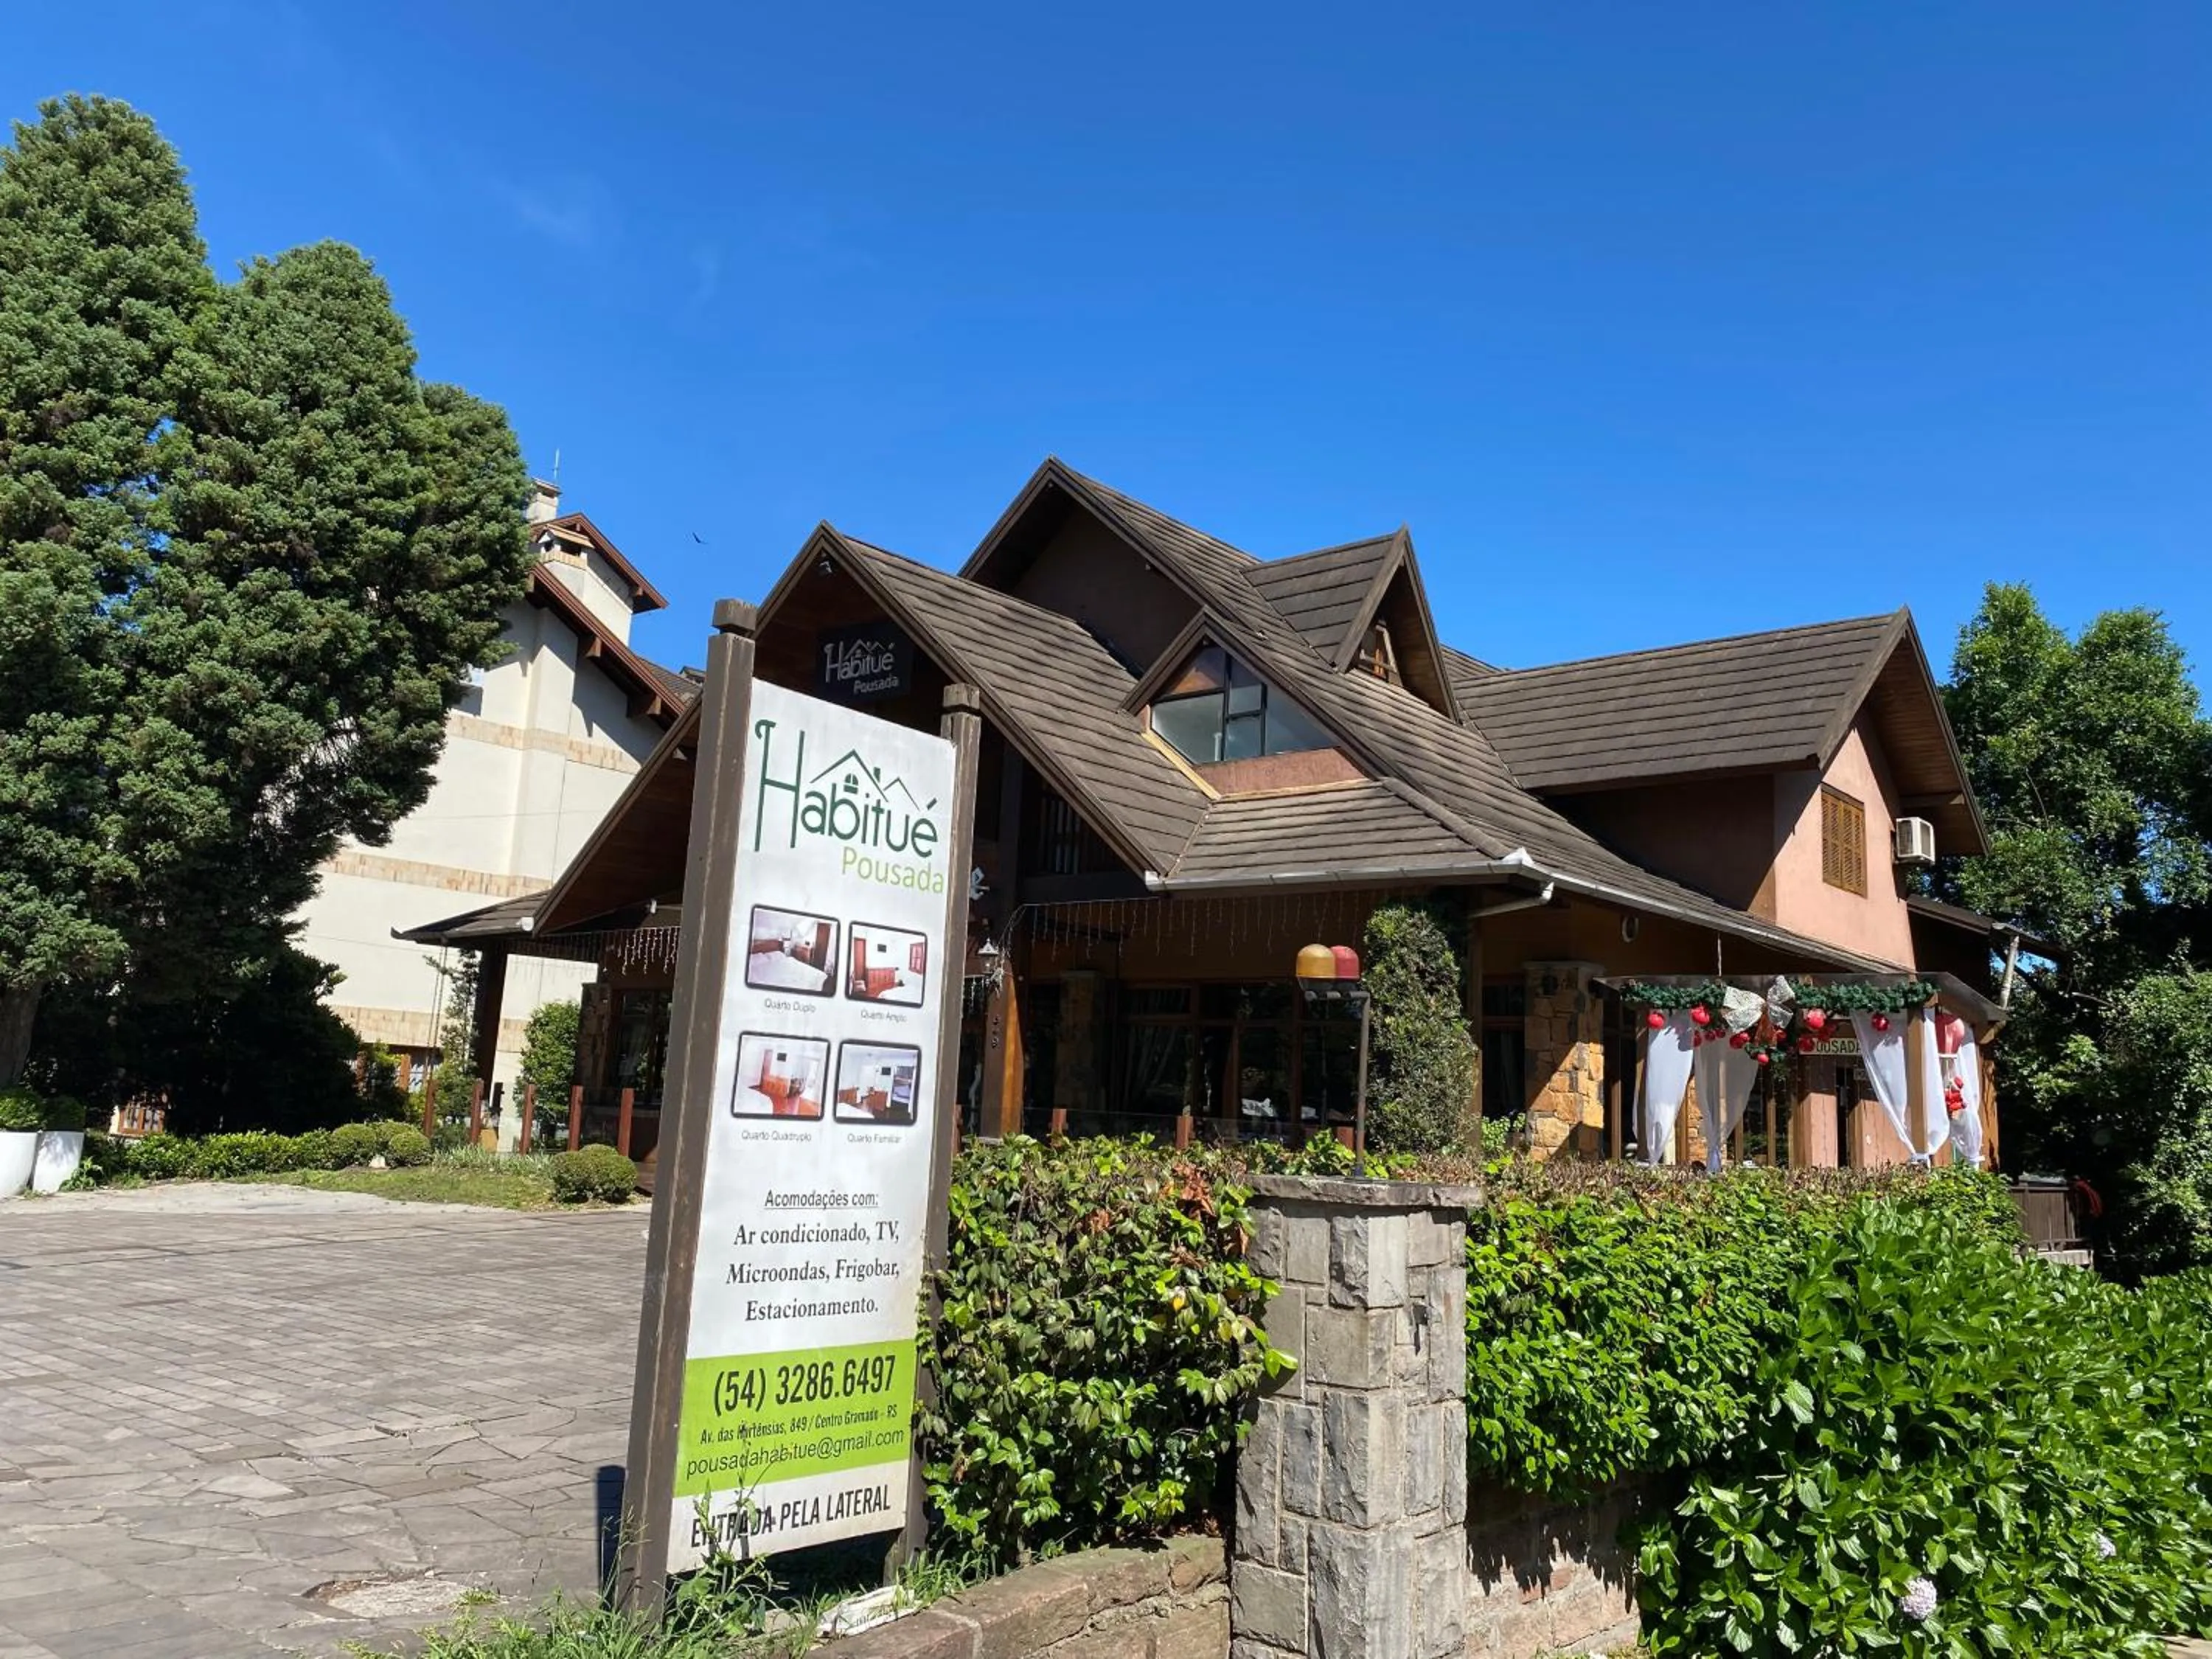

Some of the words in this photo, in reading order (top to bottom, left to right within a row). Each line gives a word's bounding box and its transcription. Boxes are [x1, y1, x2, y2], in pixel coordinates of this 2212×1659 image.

[824, 640, 895, 683] Habitué
[853, 674, 899, 695] Pousada
[754, 719, 939, 858] Habitué
[842, 846, 945, 894] Pousada
[764, 998, 791, 1011] Quarto
[741, 1130, 770, 1141] Quarto
[847, 1133, 872, 1144] Quarto
[765, 1189, 849, 1210] Acomodações
[852, 1192, 878, 1206] com:
[734, 1224, 756, 1245] Ar
[760, 1222, 871, 1245] condicionado,
[876, 1220, 900, 1243] TV,
[726, 1260, 830, 1284] Microondas,
[835, 1257, 900, 1282] Frigobar,
[745, 1297, 879, 1321] Estacionamento.
[714, 1368, 766, 1416] (54)
[776, 1354, 895, 1405] 3286.6497
[700, 1429, 714, 1444] Av.
[717, 1428, 734, 1442] das
[790, 1416, 807, 1433] 849
[815, 1413, 843, 1428] Centro
[844, 1407, 879, 1425] Gramado
[887, 1404, 897, 1418] RS
[686, 1429, 904, 1481] pousadahabitue@gmail.com
[779, 1496, 821, 1531] PELA
[827, 1484, 891, 1522] LATERAL
